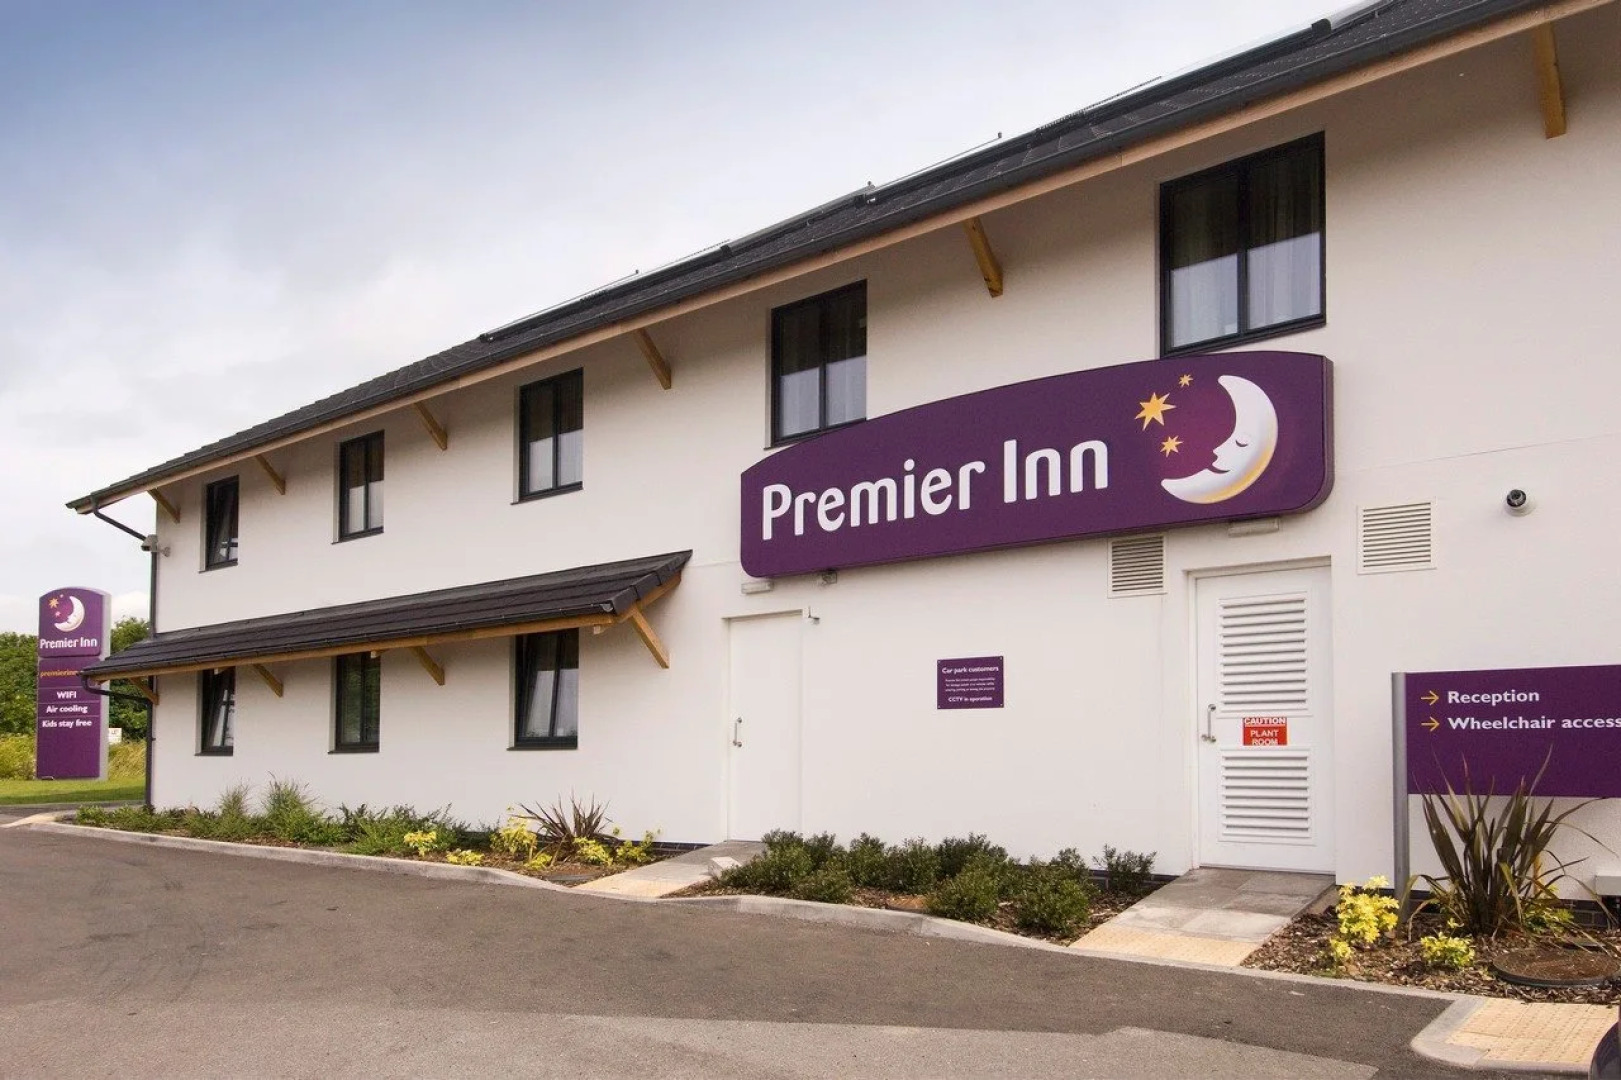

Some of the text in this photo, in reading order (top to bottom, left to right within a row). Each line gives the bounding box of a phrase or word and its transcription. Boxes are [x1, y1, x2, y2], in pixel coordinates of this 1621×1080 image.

[762, 438, 1109, 541] Premier Inn
[40, 637, 97, 648] Premier Inn
[56, 691, 77, 699] WIFI
[1447, 690, 1540, 707] Reception
[46, 704, 88, 714] Air cooling
[1244, 717, 1286, 725] CAUTION
[1447, 716, 1621, 731] Wheelchair access
[1250, 729, 1280, 738] PLANT
[1251, 738, 1279, 746] ROOM
